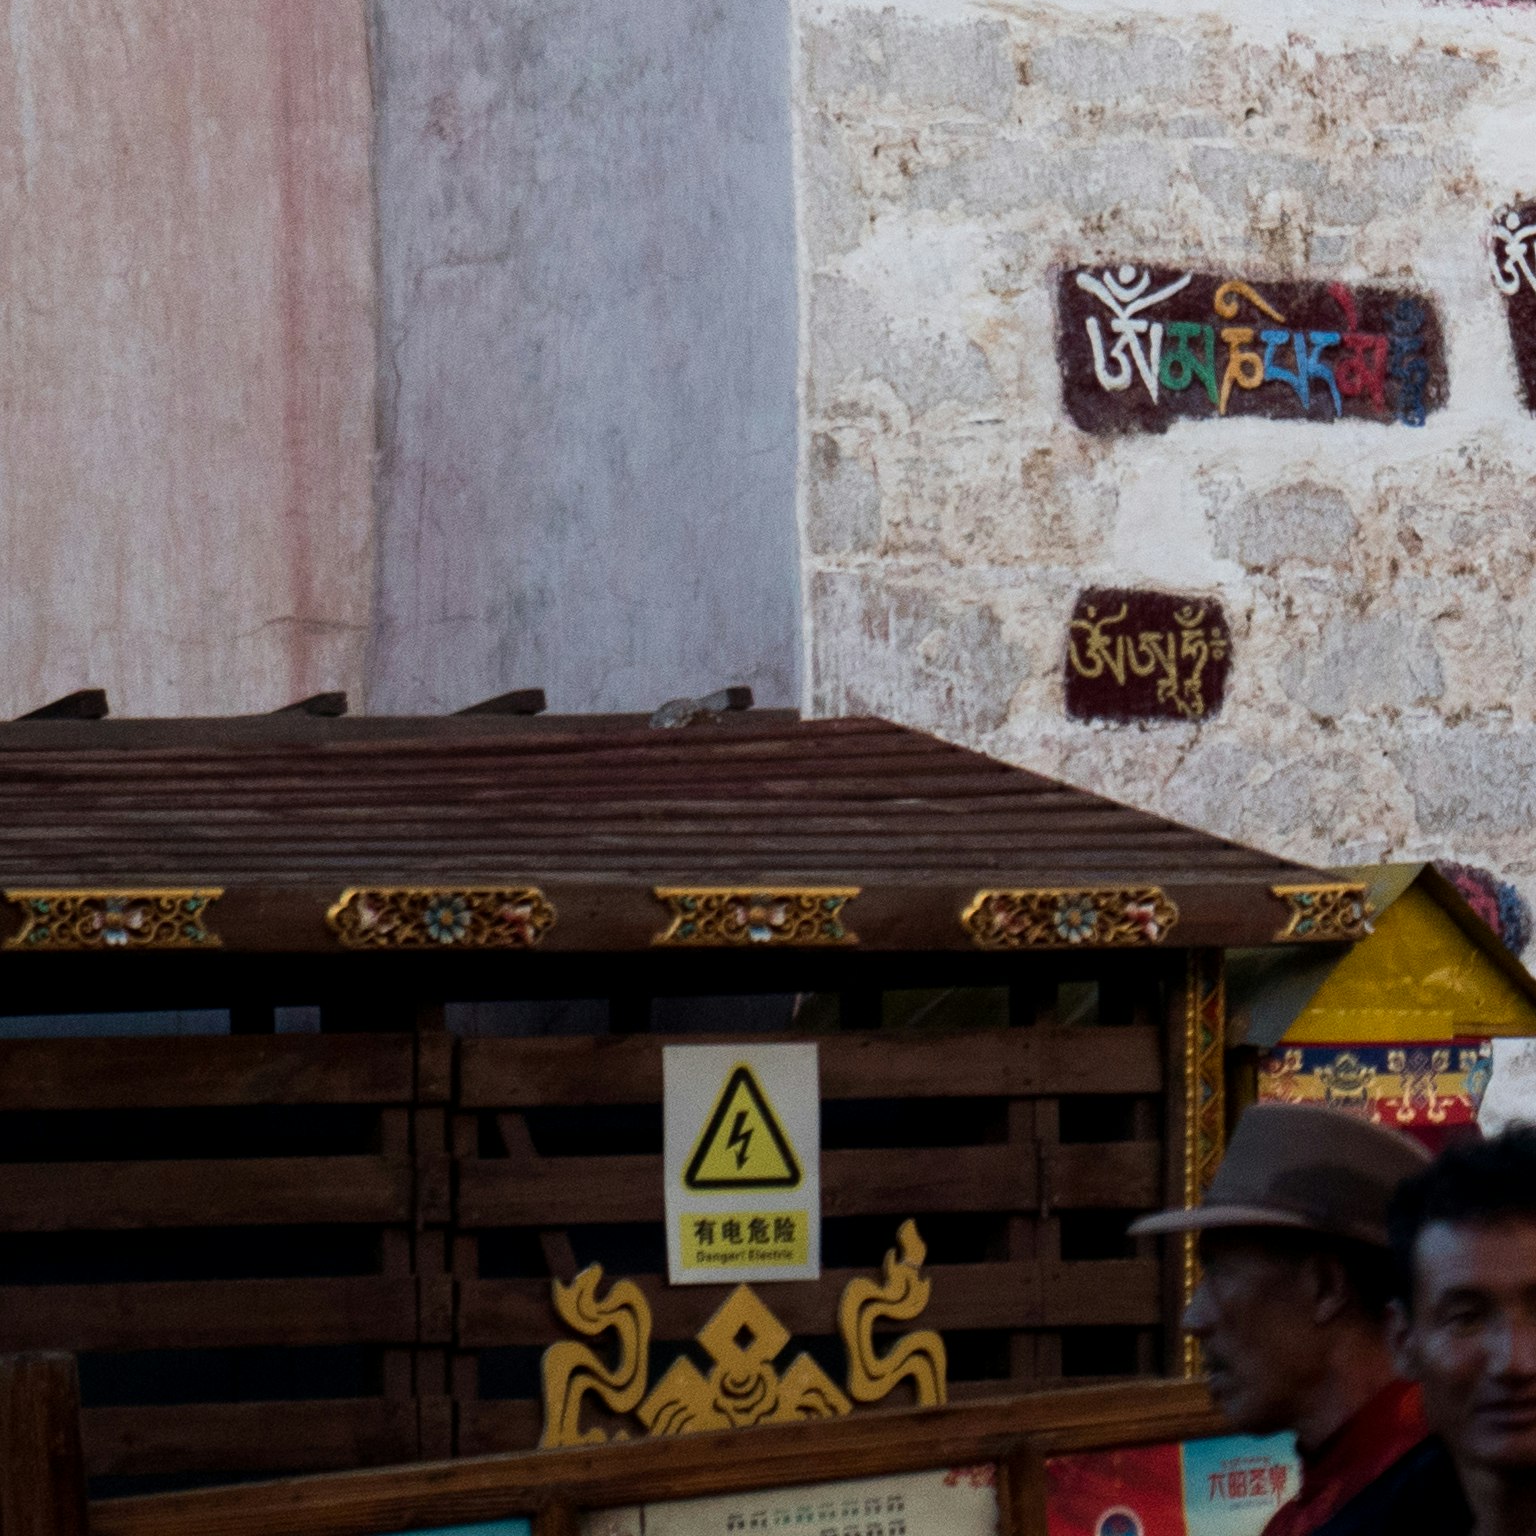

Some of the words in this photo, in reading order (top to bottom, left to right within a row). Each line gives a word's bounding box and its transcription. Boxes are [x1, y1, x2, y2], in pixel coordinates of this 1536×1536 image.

[694, 1216, 796, 1245] 有电危险
[748, 1249, 793, 1261] Electric
